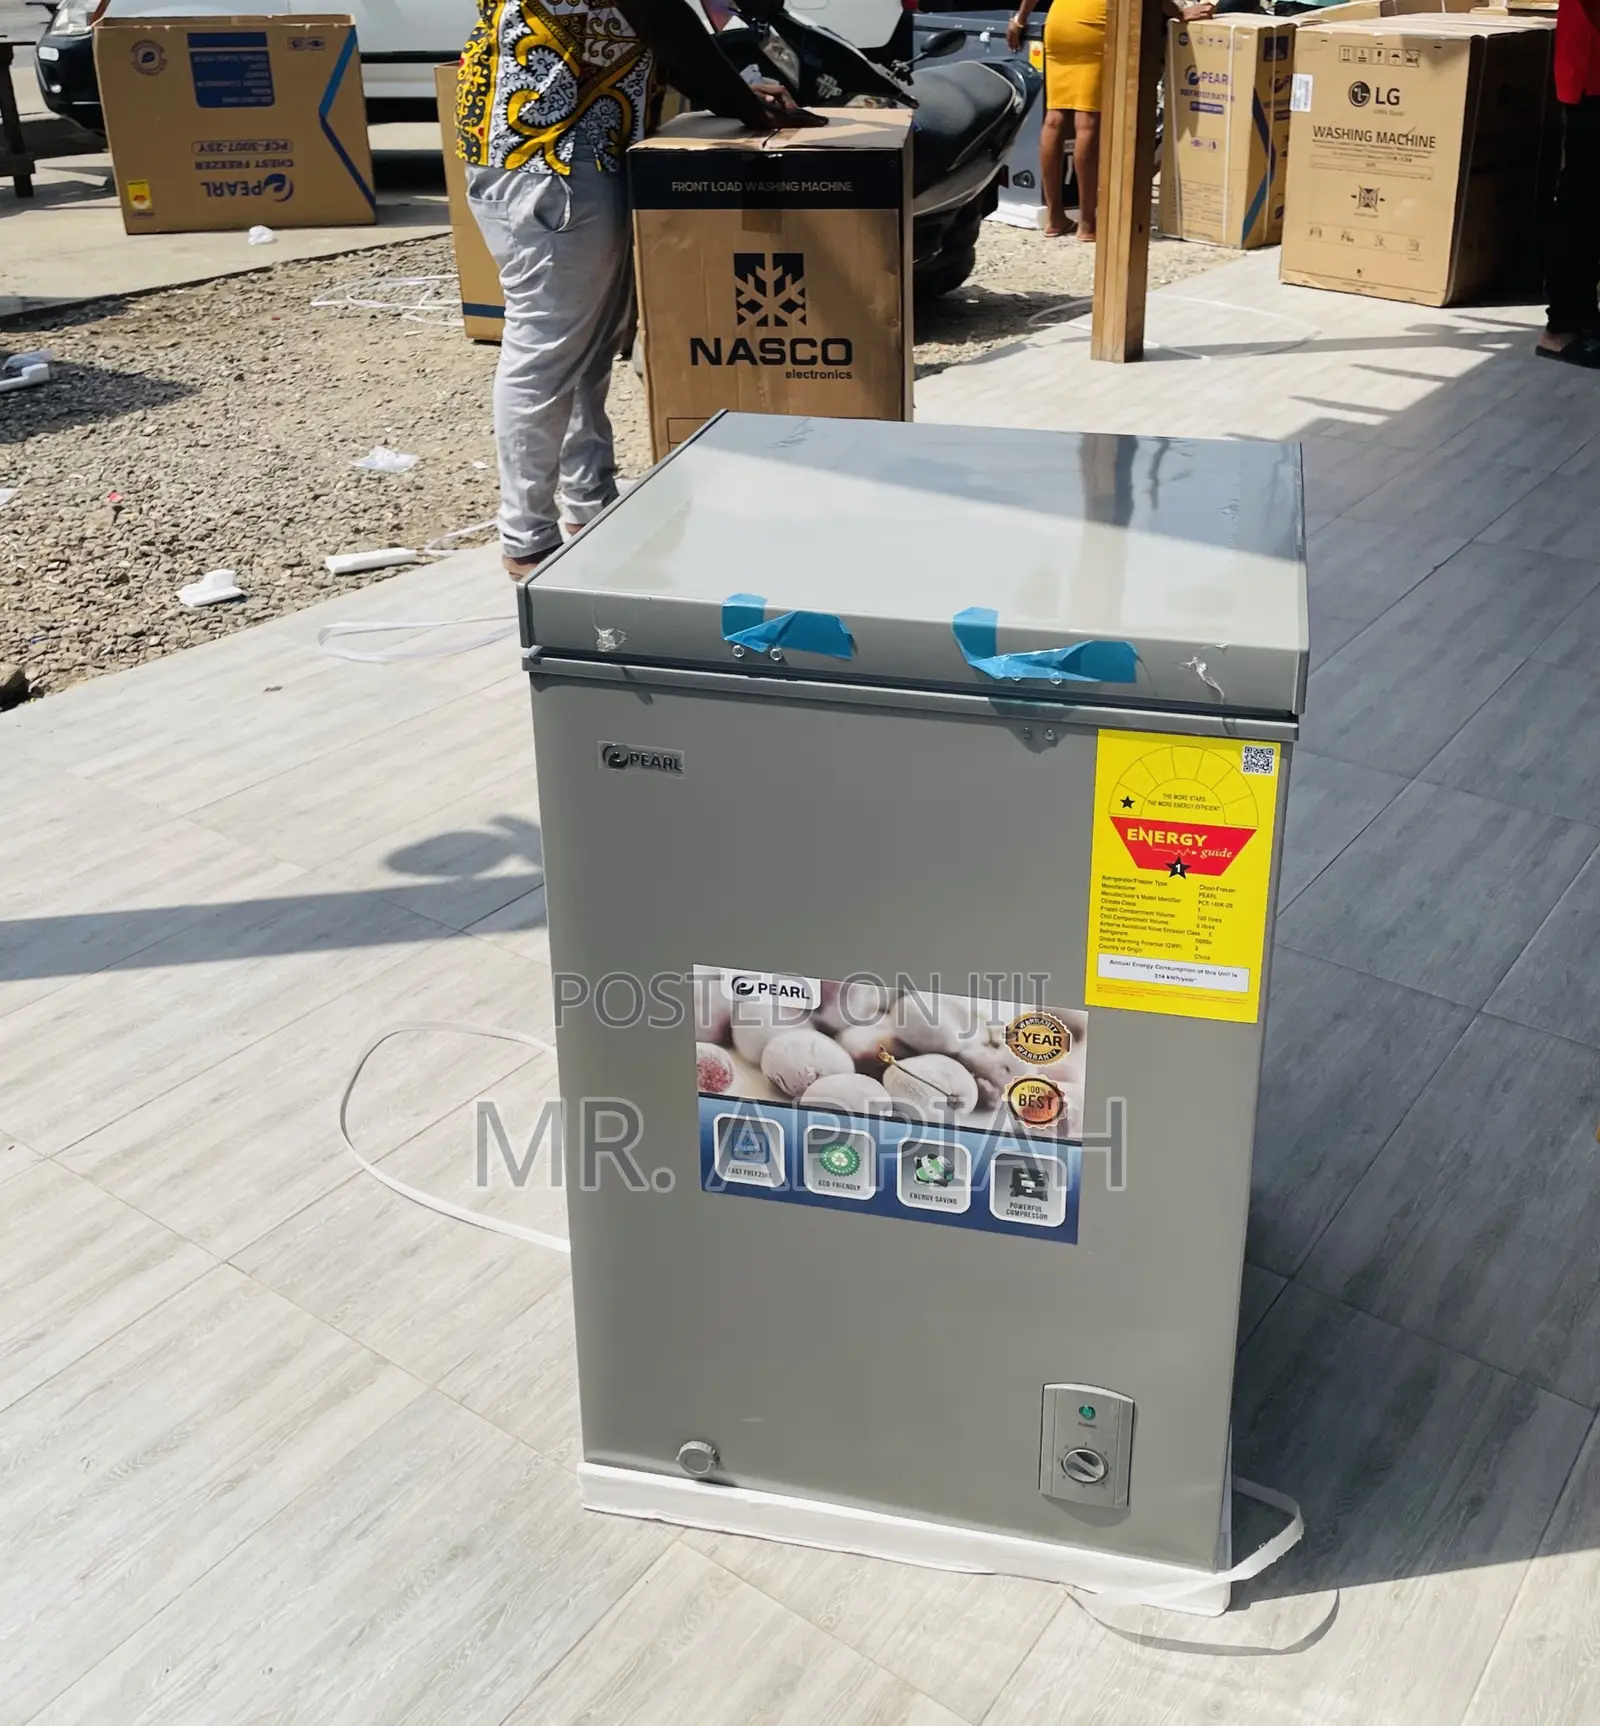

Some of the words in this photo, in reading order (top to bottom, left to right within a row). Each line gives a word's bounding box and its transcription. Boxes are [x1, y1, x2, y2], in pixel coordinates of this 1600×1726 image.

[1200, 71, 1231, 85] PEAR
[1375, 87, 1400, 105] LG
[1312, 125, 1373, 142] WASHING
[1376, 130, 1436, 149] MACHINE
[194, 159, 250, 170] FREEZER
[254, 158, 294, 168] CHEST
[201, 180, 264, 198] PEARL
[671, 181, 708, 192] FRONT
[711, 181, 742, 192] LOAD
[745, 181, 799, 192] WASHING
[801, 181, 853, 192] MACHINE
[690, 337, 853, 366] NASCO
[785, 368, 853, 380] electronics
[629, 751, 683, 773] PEARL
[1127, 826, 1207, 847] ENERGY
[1200, 847, 1232, 859] guide
[1176, 864, 1181, 873] 1
[1101, 882, 1136, 891] Manufacturer
[1099, 944, 1119, 952] Country
[1109, 959, 1131, 967] Annual
[1132, 961, 1154, 970] Energy
[1154, 964, 1196, 974] Consumption
[758, 982, 811, 1000] PEARL
[1019, 1017, 1059, 1033] WARRANTY
[1022, 1031, 1063, 1047] YEAR
[1017, 1045, 1058, 1061] WARRANTY
[1018, 1093, 1054, 1110] BEST
[909, 1193, 934, 1202] ENERGY
[935, 1195, 958, 1205] SAVING
[1005, 1209, 1048, 1220] COMPRESSOR
[1009, 1202, 1042, 1213] POWERFUL
